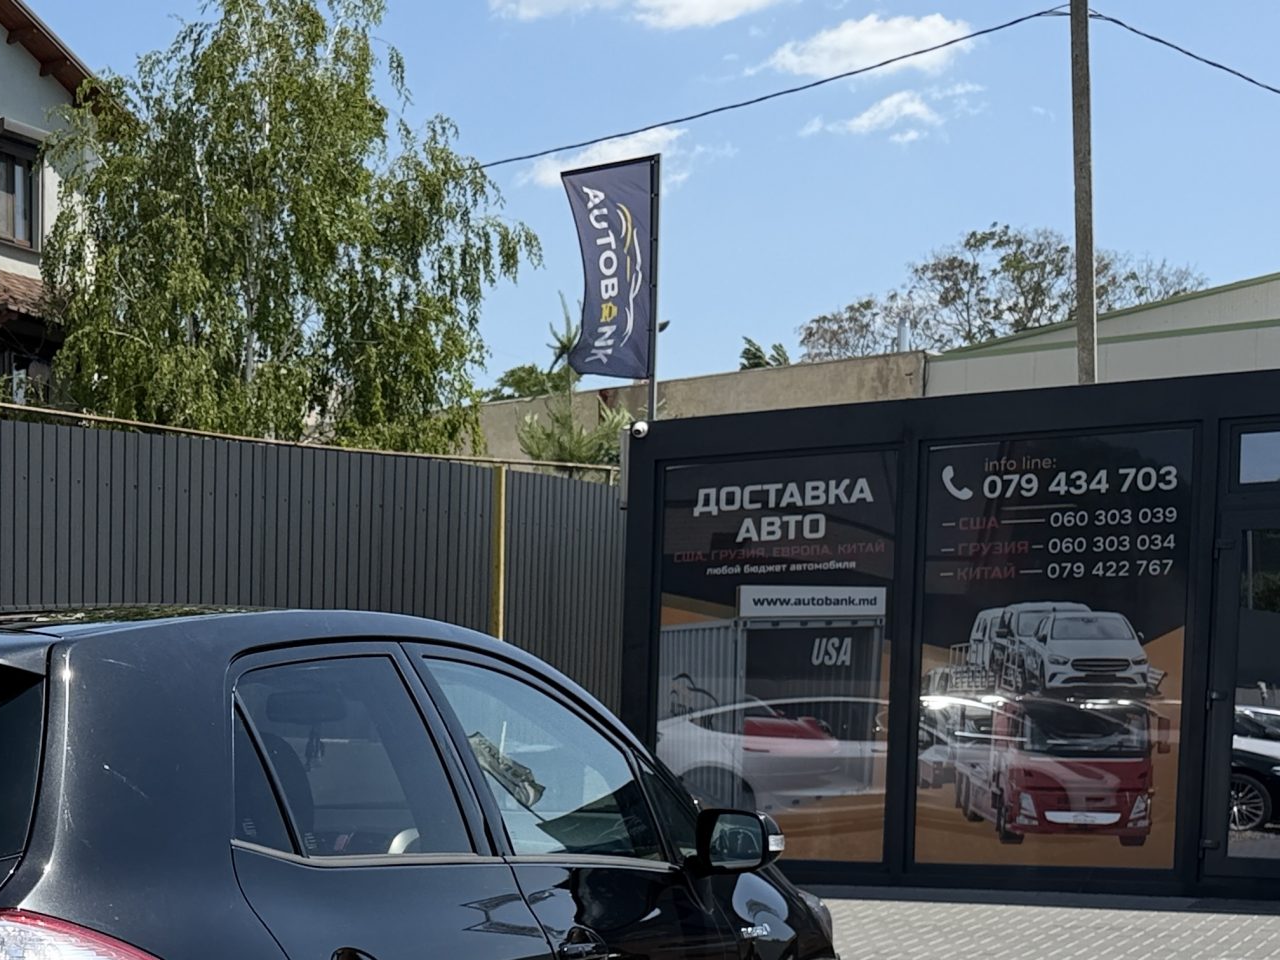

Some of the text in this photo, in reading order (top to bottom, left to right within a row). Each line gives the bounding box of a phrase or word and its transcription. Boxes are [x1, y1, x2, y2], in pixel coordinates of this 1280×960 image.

[582, 185, 619, 365] AUTOBANK
[984, 455, 1057, 472] info line:
[983, 465, 1178, 499] 079 434 703
[693, 477, 874, 517] ДОСТАВКА
[735, 513, 826, 543] АВТО
[959, 507, 1177, 530] США 060 303 039
[838, 539, 885, 554] КИТАЙ
[958, 534, 1176, 556] ГРУЗИЯ 060 303 034
[706, 560, 856, 575] любой бюджет автомобиля
[956, 559, 1174, 580] КИТАЙ 079 422 767
[752, 595, 878, 608] www.autobank.md
[810, 637, 852, 667] USA
